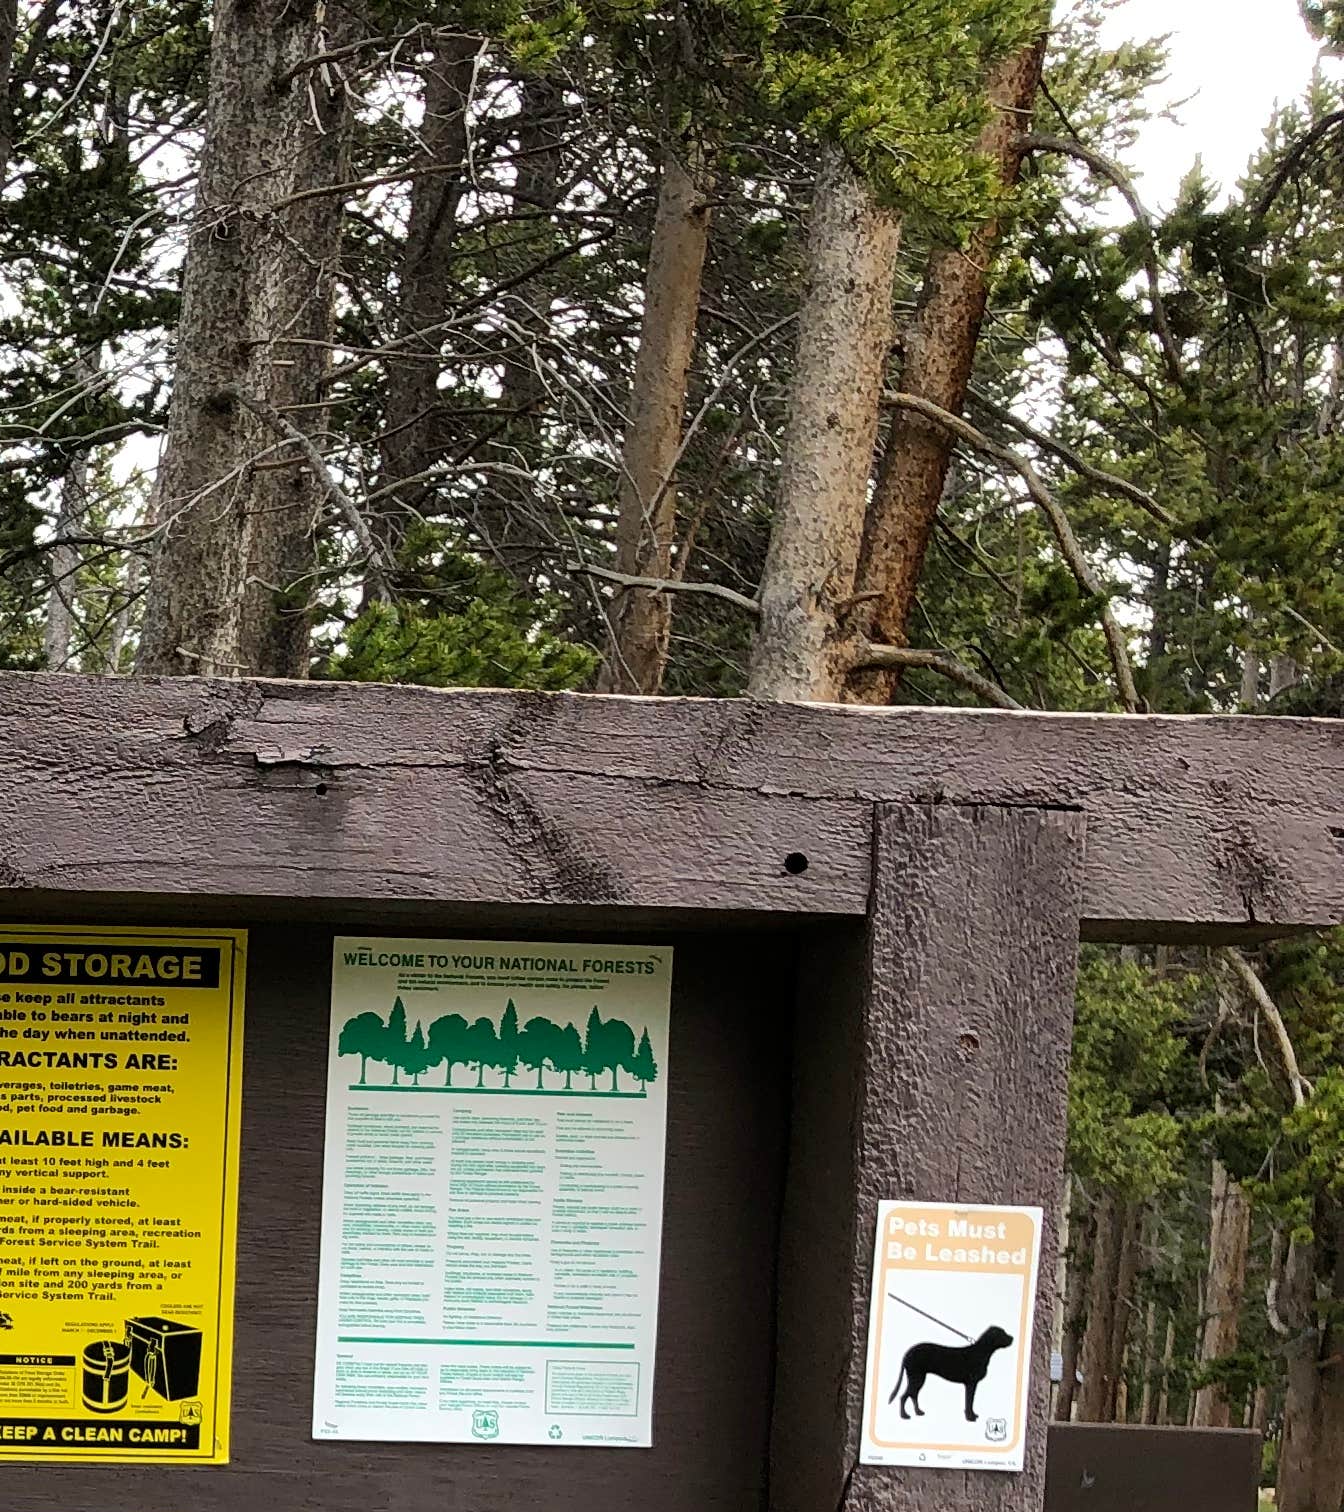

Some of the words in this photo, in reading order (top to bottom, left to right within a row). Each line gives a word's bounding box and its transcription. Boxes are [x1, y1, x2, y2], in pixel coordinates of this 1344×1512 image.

[41, 953, 202, 979] STORAGE
[344, 953, 424, 968] WELCOME
[428, 955, 448, 969] TO
[452, 955, 495, 971] YOUR
[500, 957, 578, 972] NATIONAL
[583, 960, 654, 974] FORESTS
[125, 1054, 178, 1070] ARE:
[102, 1132, 189, 1148] MEANS:
[889, 1217, 939, 1237] Pets
[948, 1220, 1006, 1239] Must
[888, 1242, 917, 1260] Be
[926, 1244, 1026, 1264] Leashed
[43, 1426, 58, 1441] A
[62, 1426, 124, 1442] CLEAN
[129, 1427, 186, 1443] CAMP!
